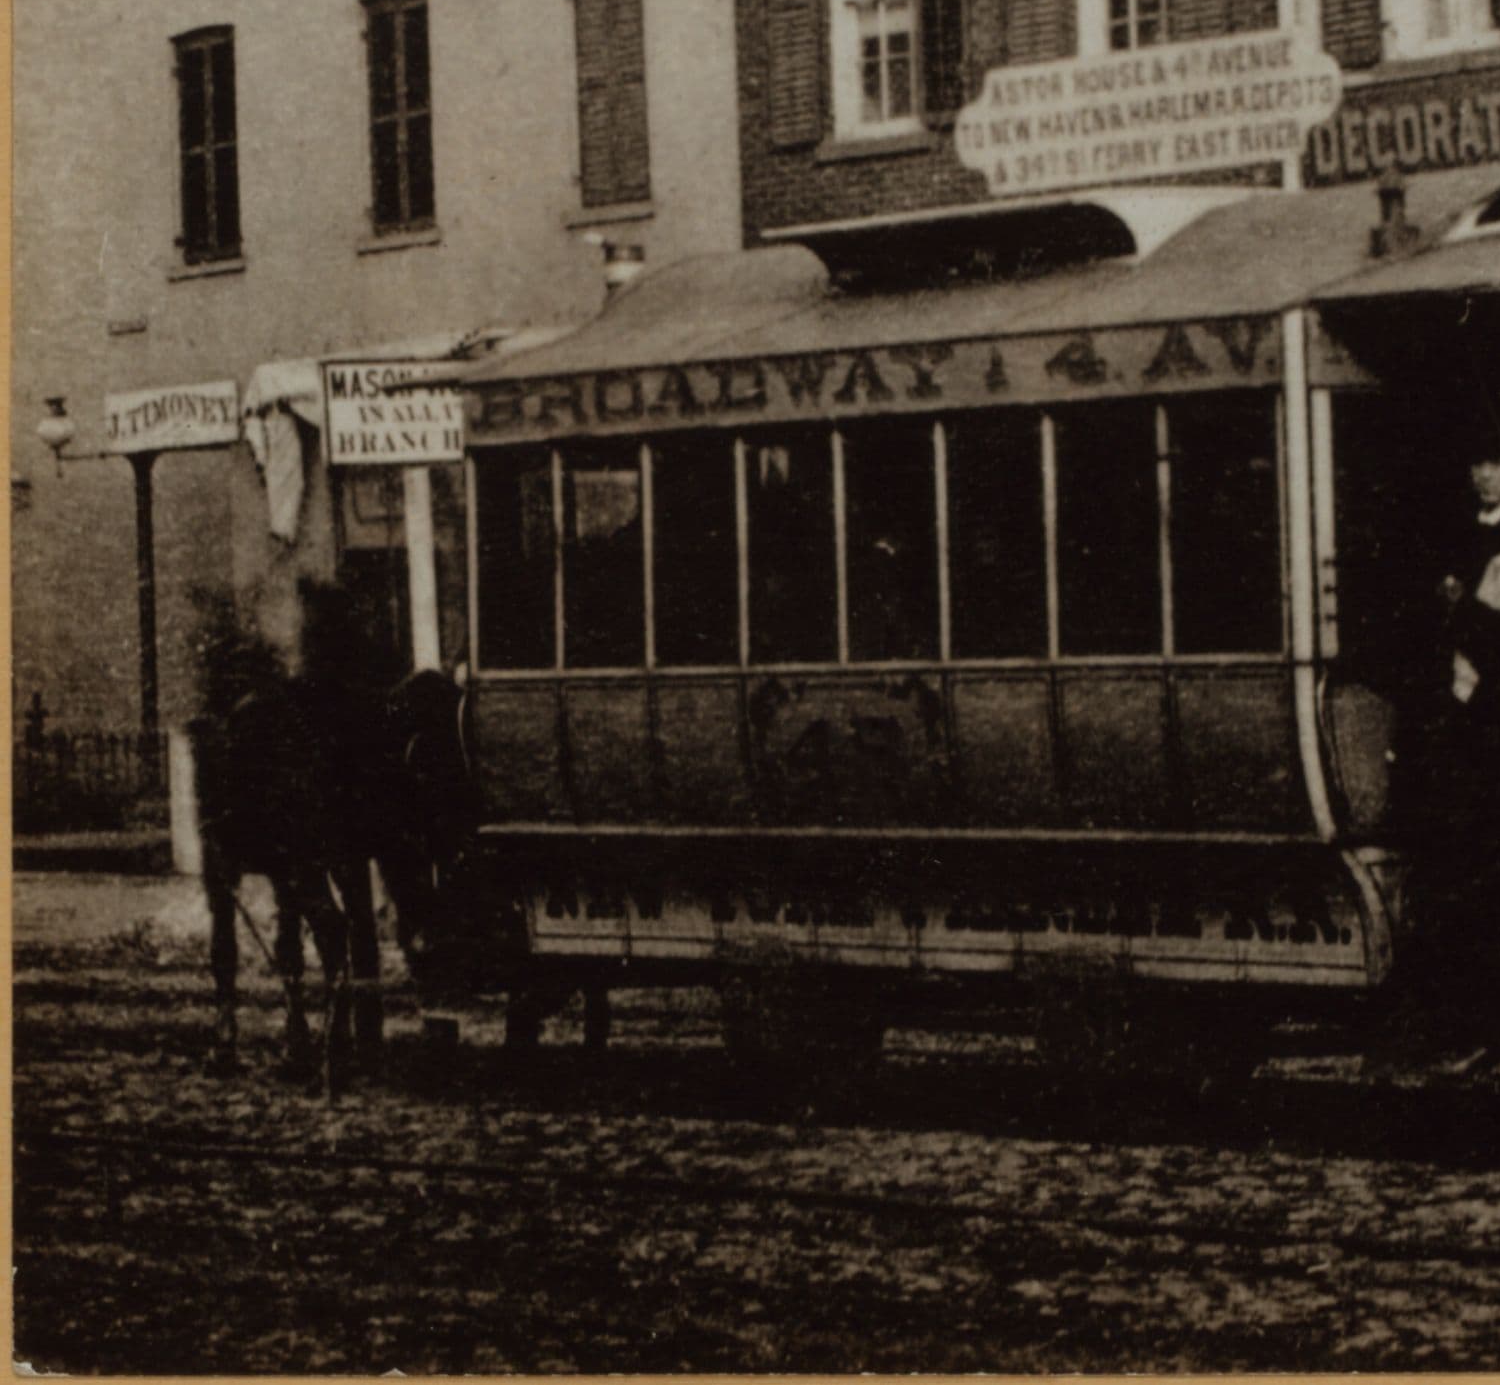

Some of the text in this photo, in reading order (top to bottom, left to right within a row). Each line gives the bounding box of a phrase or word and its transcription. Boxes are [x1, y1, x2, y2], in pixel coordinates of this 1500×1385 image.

[991, 70, 1063, 107] ASTOR
[1073, 59, 1146, 94] HOUSE
[1208, 37, 1293, 75] AVENUE
[989, 117, 1031, 145] NEW
[1173, 126, 1231, 164] EAST
[470, 345, 952, 432] BROADWAY
